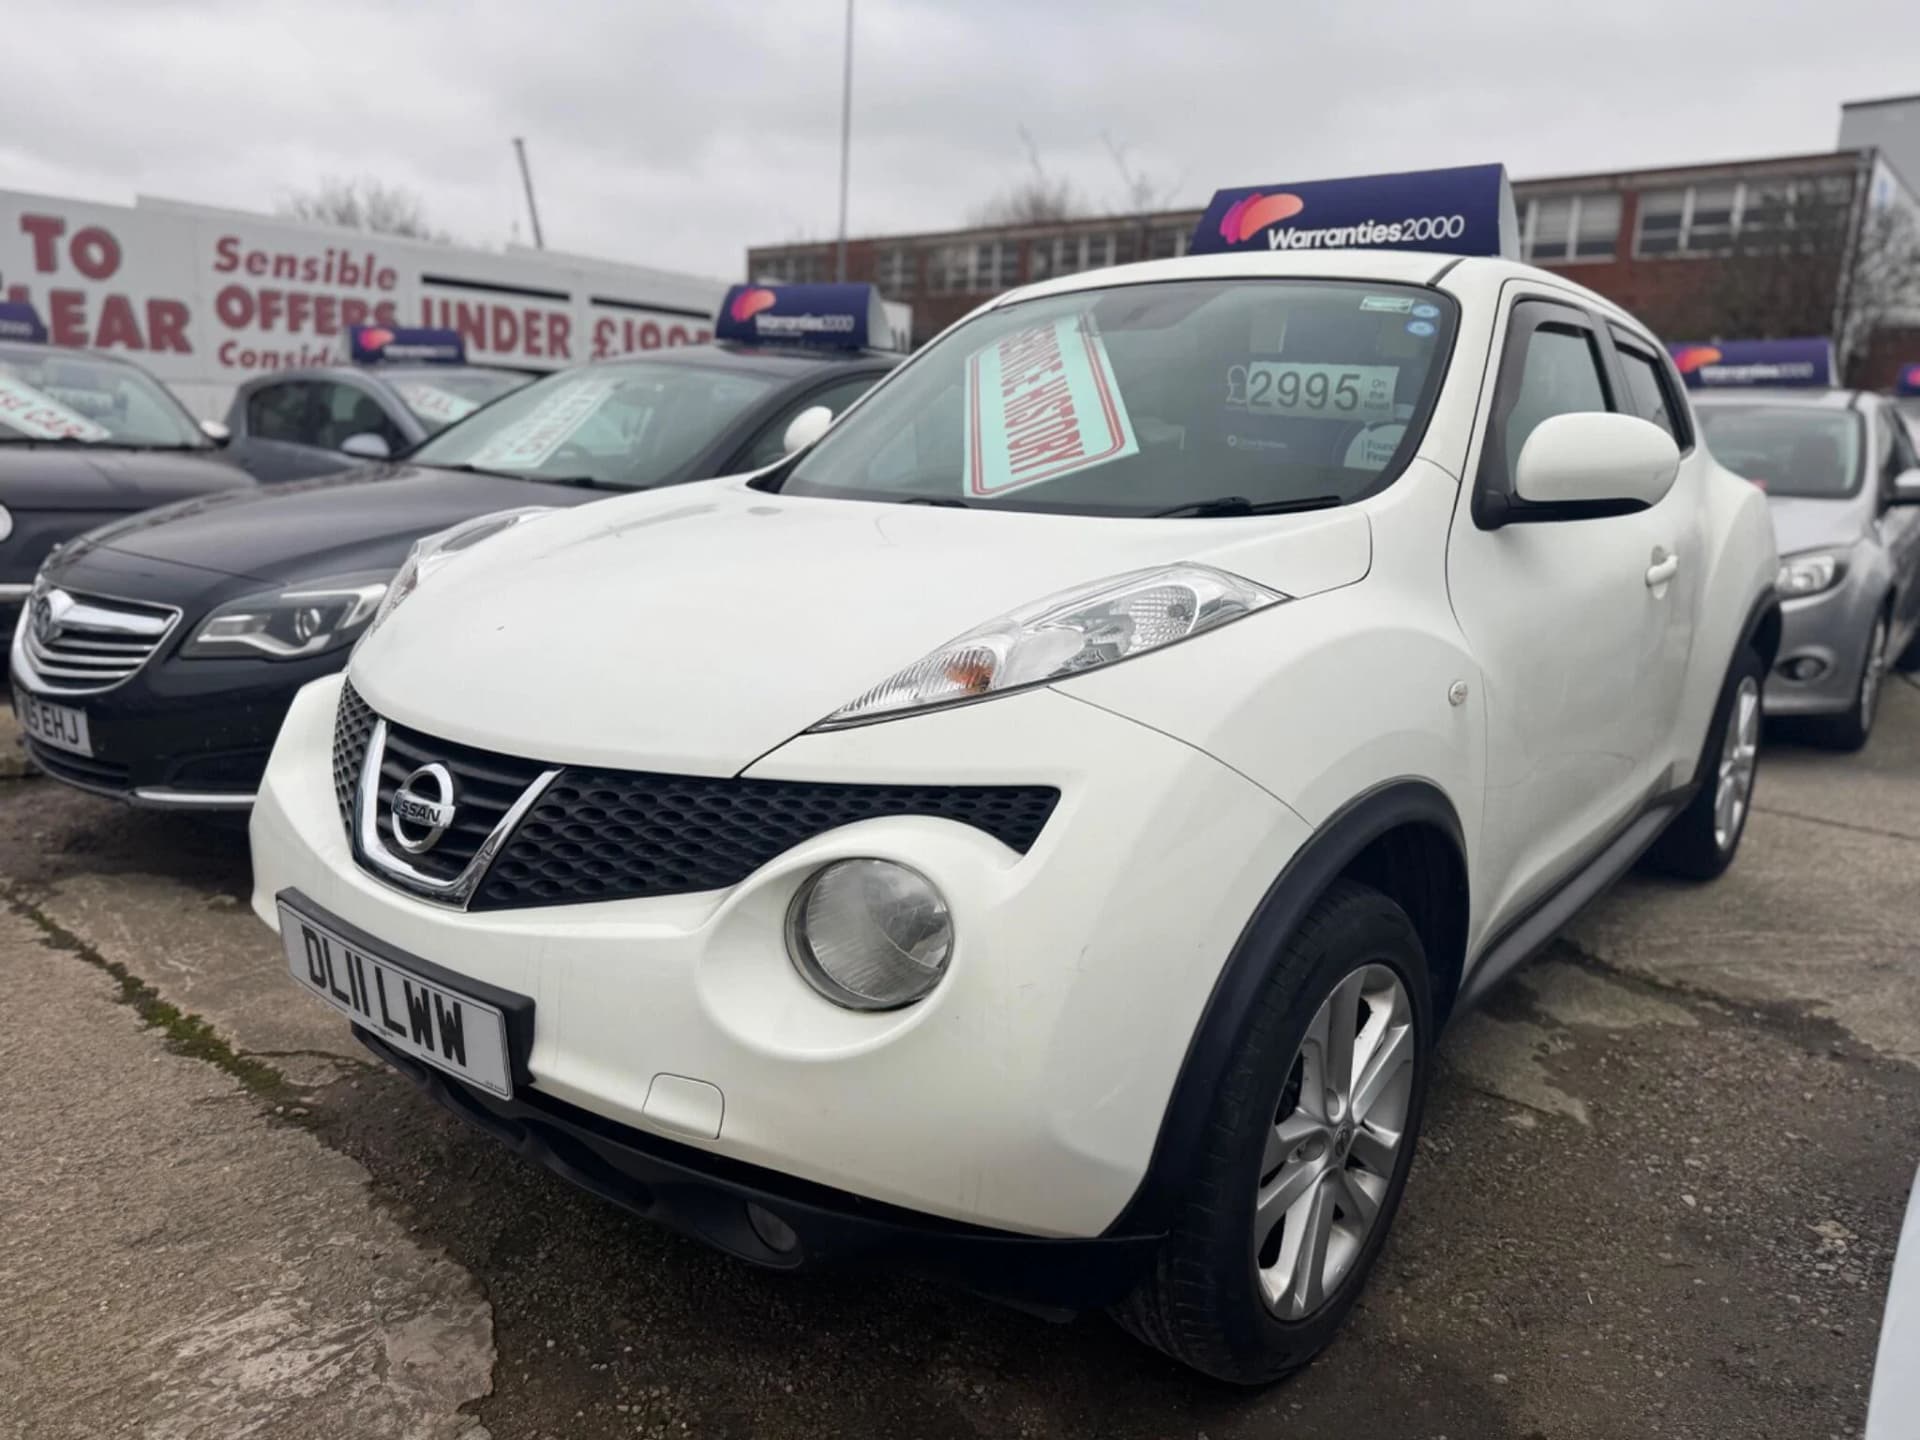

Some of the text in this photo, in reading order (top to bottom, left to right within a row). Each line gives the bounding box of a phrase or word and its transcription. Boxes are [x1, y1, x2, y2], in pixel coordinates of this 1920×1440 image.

[20, 214, 121, 280] TO
[1268, 214, 1465, 251] Warranties2000
[214, 236, 397, 291] Sensible
[421, 296, 571, 357] UNDER
[1004, 374, 1085, 475] HISTORY
[41, 705, 79, 744] EHJ
[374, 964, 467, 1068] LWW
